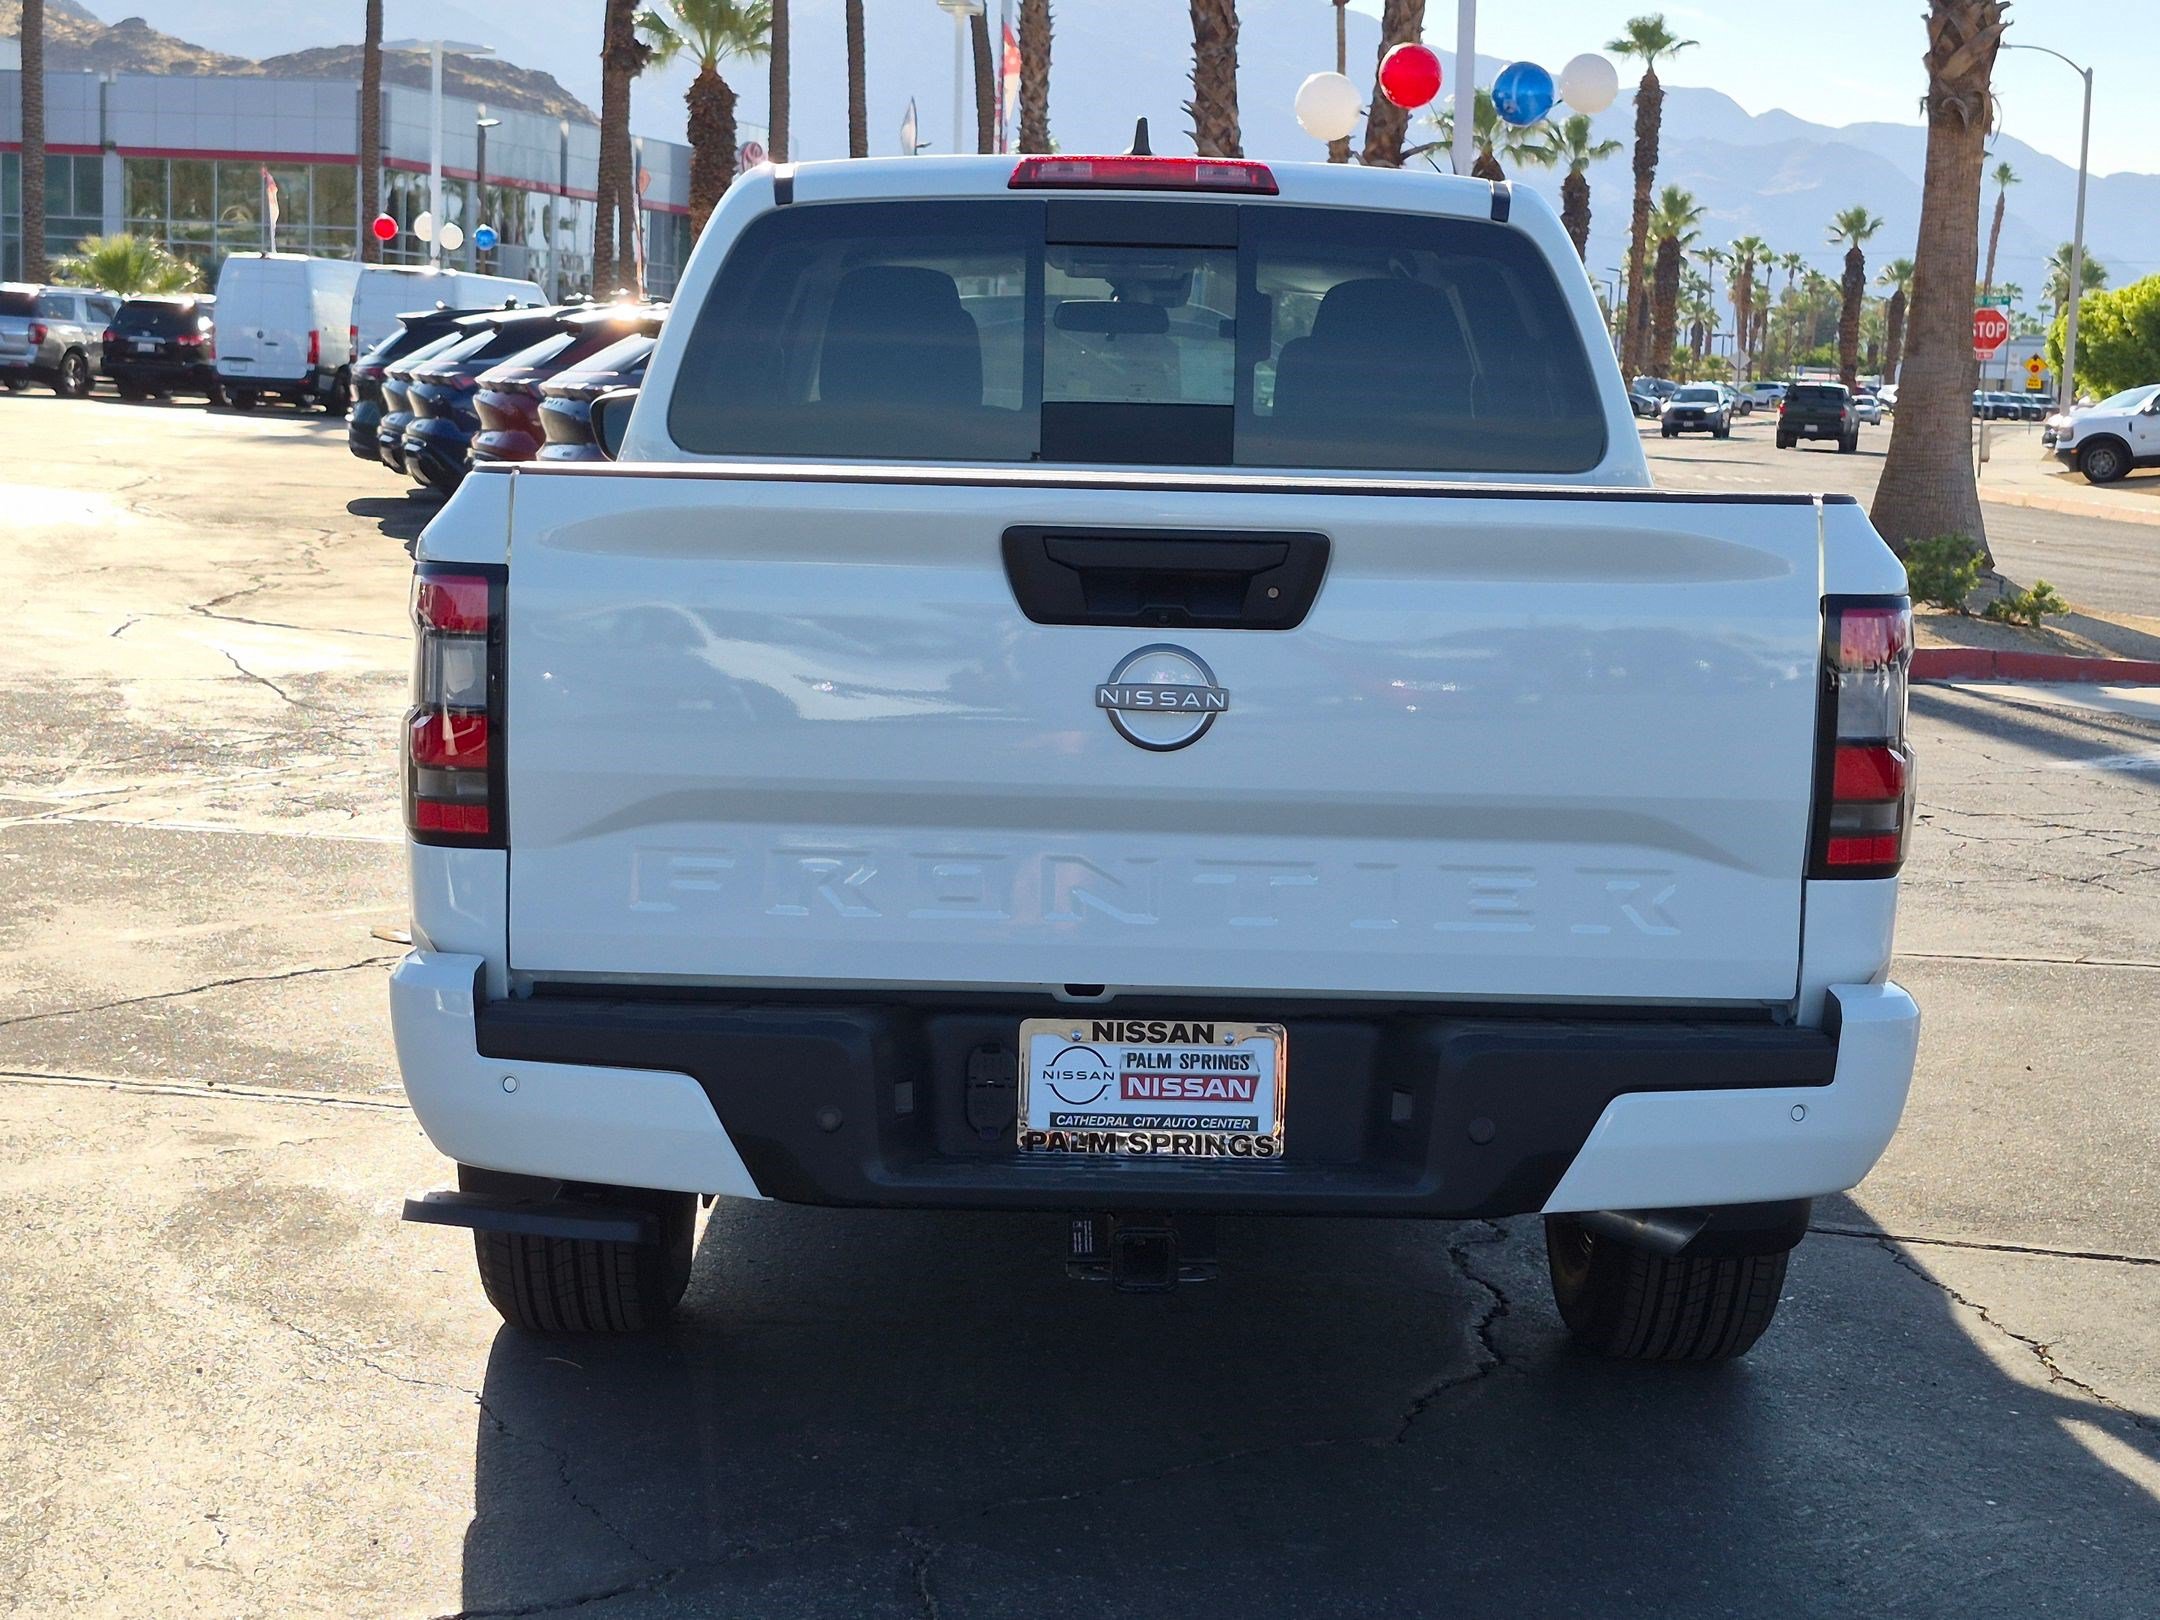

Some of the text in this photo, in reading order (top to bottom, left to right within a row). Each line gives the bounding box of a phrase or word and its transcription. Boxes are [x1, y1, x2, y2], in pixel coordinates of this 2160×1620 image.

[1100, 688, 1224, 708] NISSAN
[628, 847, 1682, 935] FRONTIER
[1092, 1021, 1215, 1044] NISSAN
[1126, 1052, 1250, 1071] PALM SPRINGS
[1042, 1070, 1115, 1081] NISSAN
[1127, 1076, 1251, 1099] NISSAN
[1056, 1114, 1251, 1130] CATHEDRAL CITY AUTO CENTER
[1026, 1131, 1276, 1157] PALM SPRINGS
